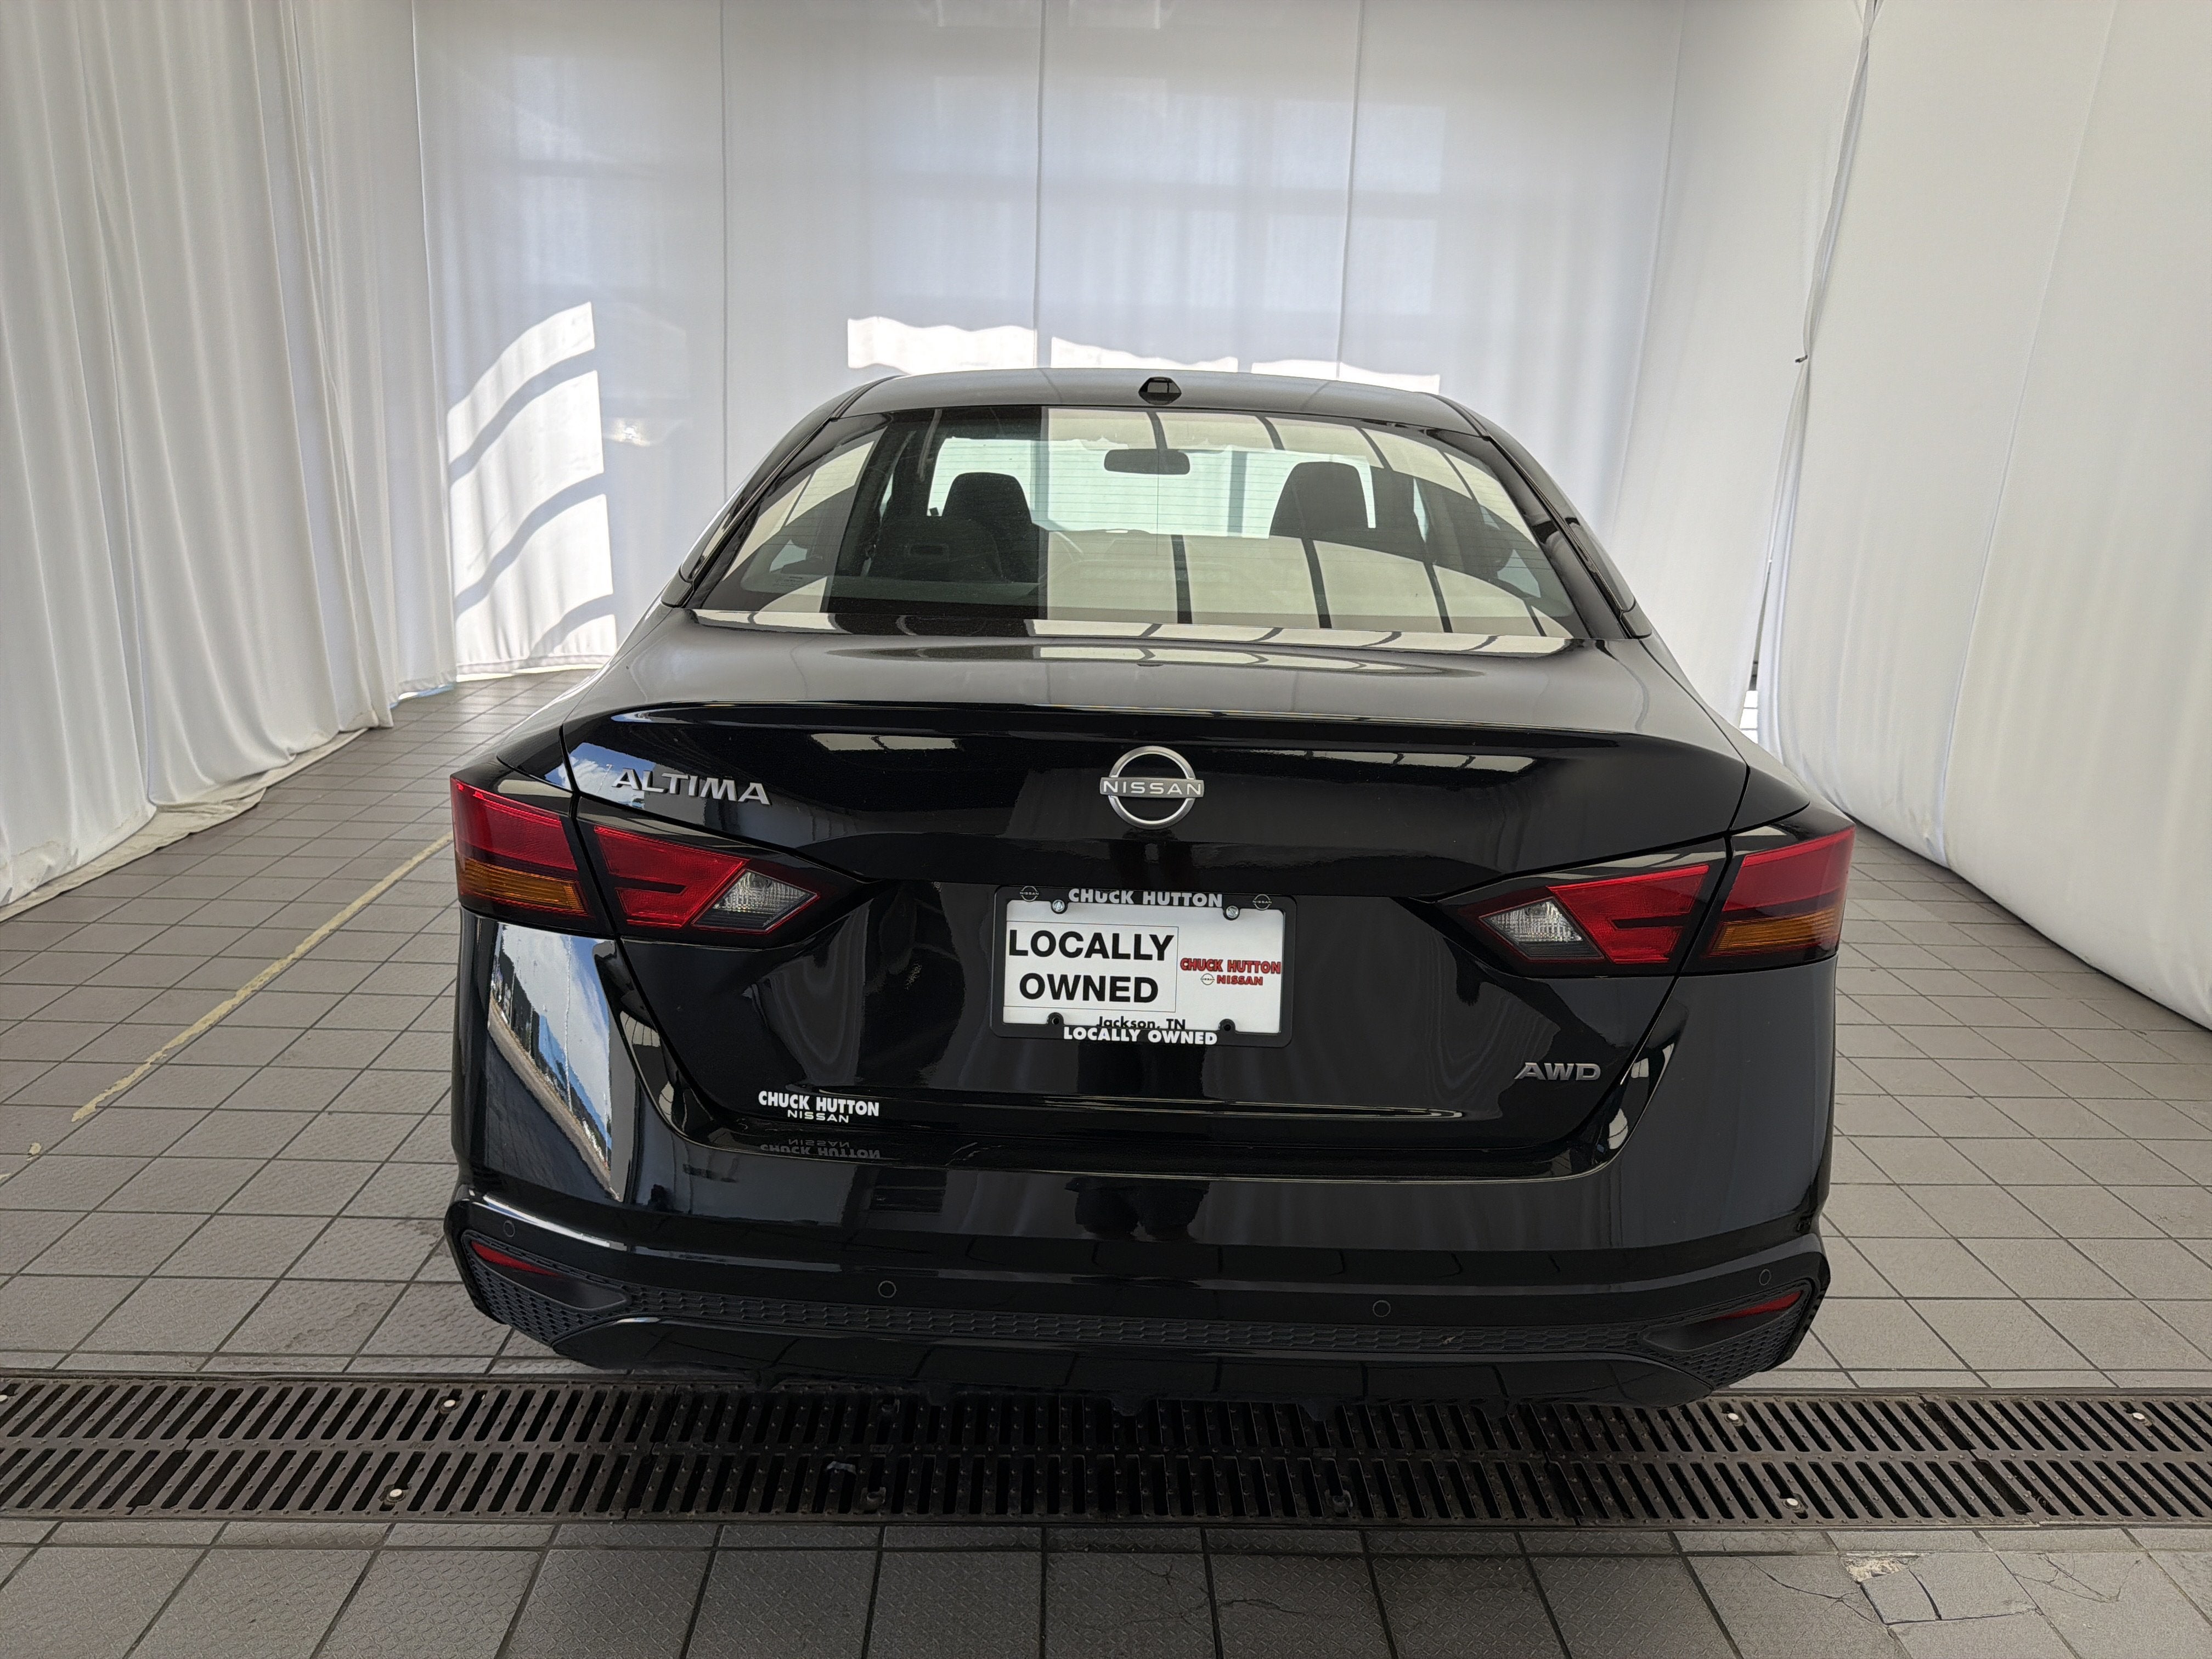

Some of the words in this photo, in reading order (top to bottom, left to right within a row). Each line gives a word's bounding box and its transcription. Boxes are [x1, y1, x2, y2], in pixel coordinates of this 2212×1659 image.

[611, 768, 772, 806] ALTIMA
[1103, 780, 1201, 795] NISSAN
[1068, 888, 1135, 905] CHUCK
[1142, 891, 1223, 907] HUTTON
[1008, 929, 1175, 961] LOCALLY
[1180, 957, 1223, 972] CHUCK
[1227, 959, 1281, 974] HUTTON
[1019, 972, 1159, 1003] OWNED
[1216, 974, 1263, 986] NISSAN
[1097, 1015, 1160, 1029] Jackson,
[1166, 1018, 1186, 1030] TN
[1063, 1026, 1141, 1042] LOCALLY
[1147, 1030, 1218, 1045] OWNED
[1514, 1062, 1601, 1081] AWD
[758, 1090, 810, 1110] CHUCK
[815, 1096, 879, 1117] HUTTON
[787, 1109, 849, 1124] NISSAN
